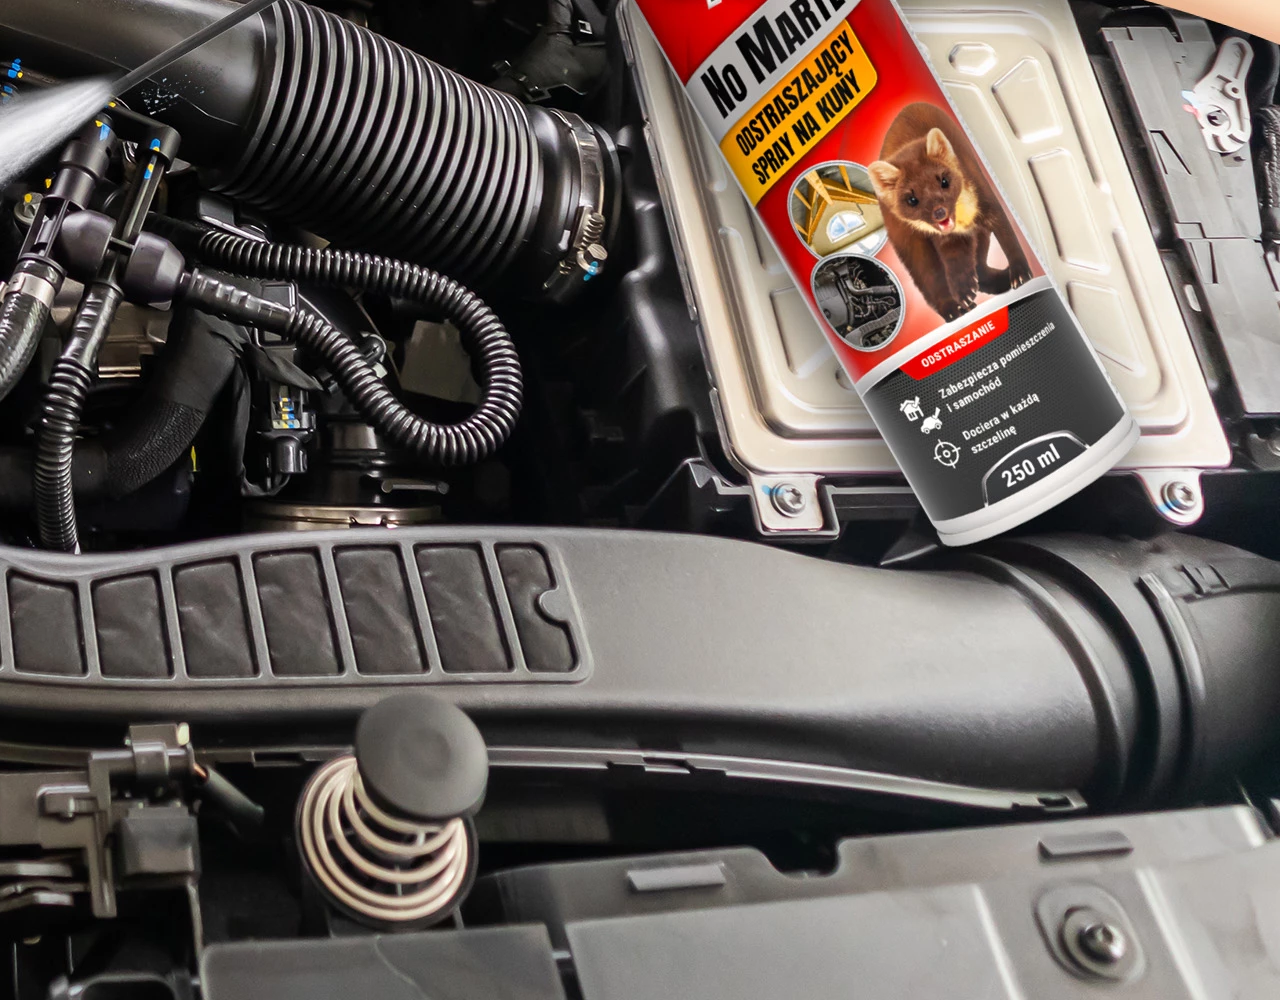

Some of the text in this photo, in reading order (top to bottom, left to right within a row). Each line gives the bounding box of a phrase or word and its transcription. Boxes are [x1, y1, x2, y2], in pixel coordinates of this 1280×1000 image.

[736, 30, 853, 156] ODSTRASZAJĄCY
[752, 70, 860, 184] SPRAY NA KUNY
[921, 320, 996, 368] ODSTRASZANIE
[937, 321, 1056, 399] Zabezpiecza pomieszczenia
[945, 376, 1003, 413] i samochód
[961, 393, 1041, 441] Dociera w każdą
[970, 425, 1018, 454] szczelinę
[1001, 443, 1061, 488] 250 ml
